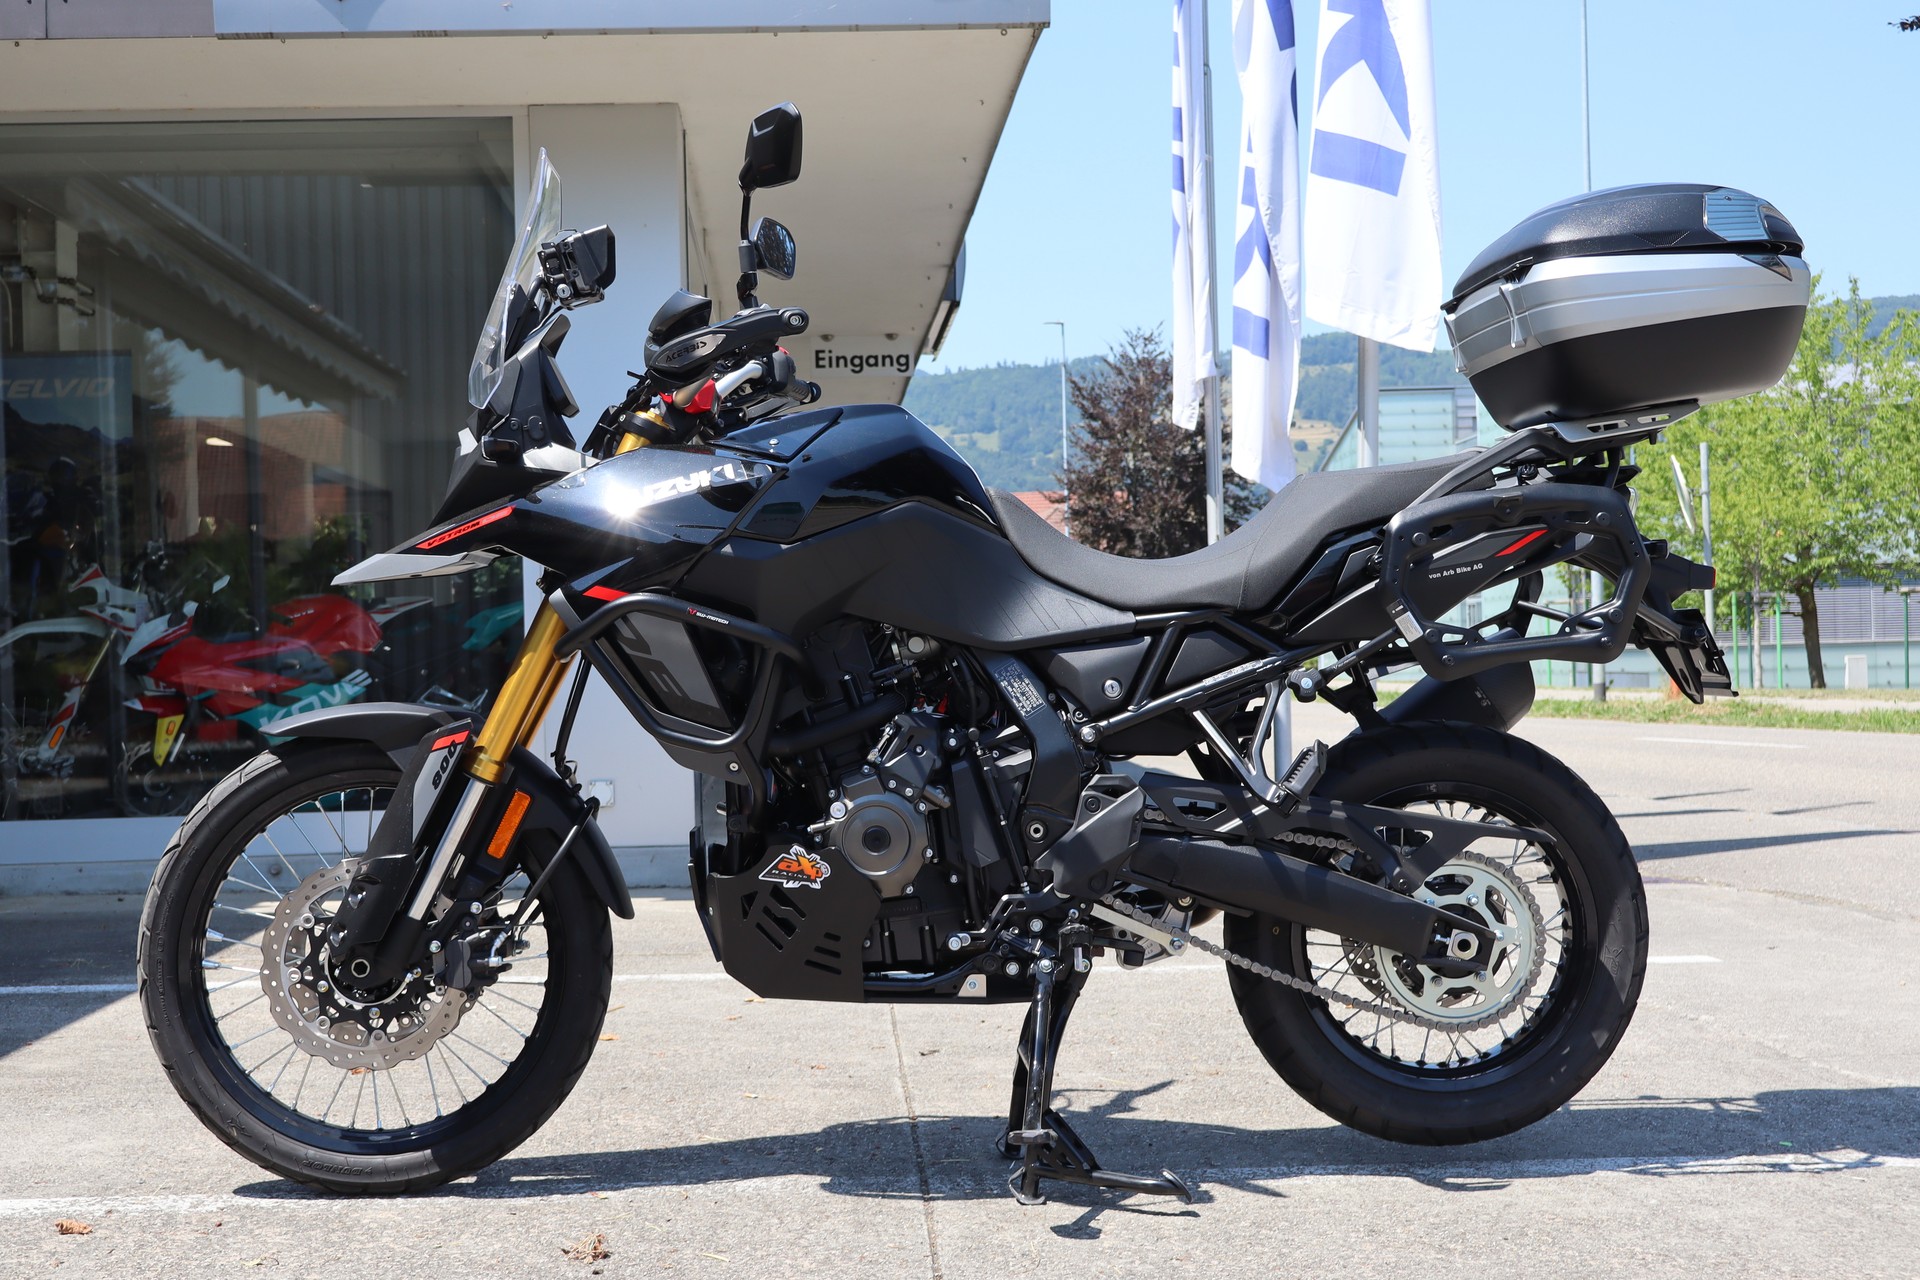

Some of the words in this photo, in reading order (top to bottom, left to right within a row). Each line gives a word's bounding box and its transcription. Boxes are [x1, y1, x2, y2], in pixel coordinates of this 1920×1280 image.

[666, 340, 708, 363] ACERBIS
[815, 349, 910, 374] Eingang
[427, 520, 481, 547] V-STROM
[1442, 569, 1455, 577] Arb
[1456, 566, 1472, 574] Bike
[1473, 562, 1484, 571] AG
[431, 740, 458, 790] 800
